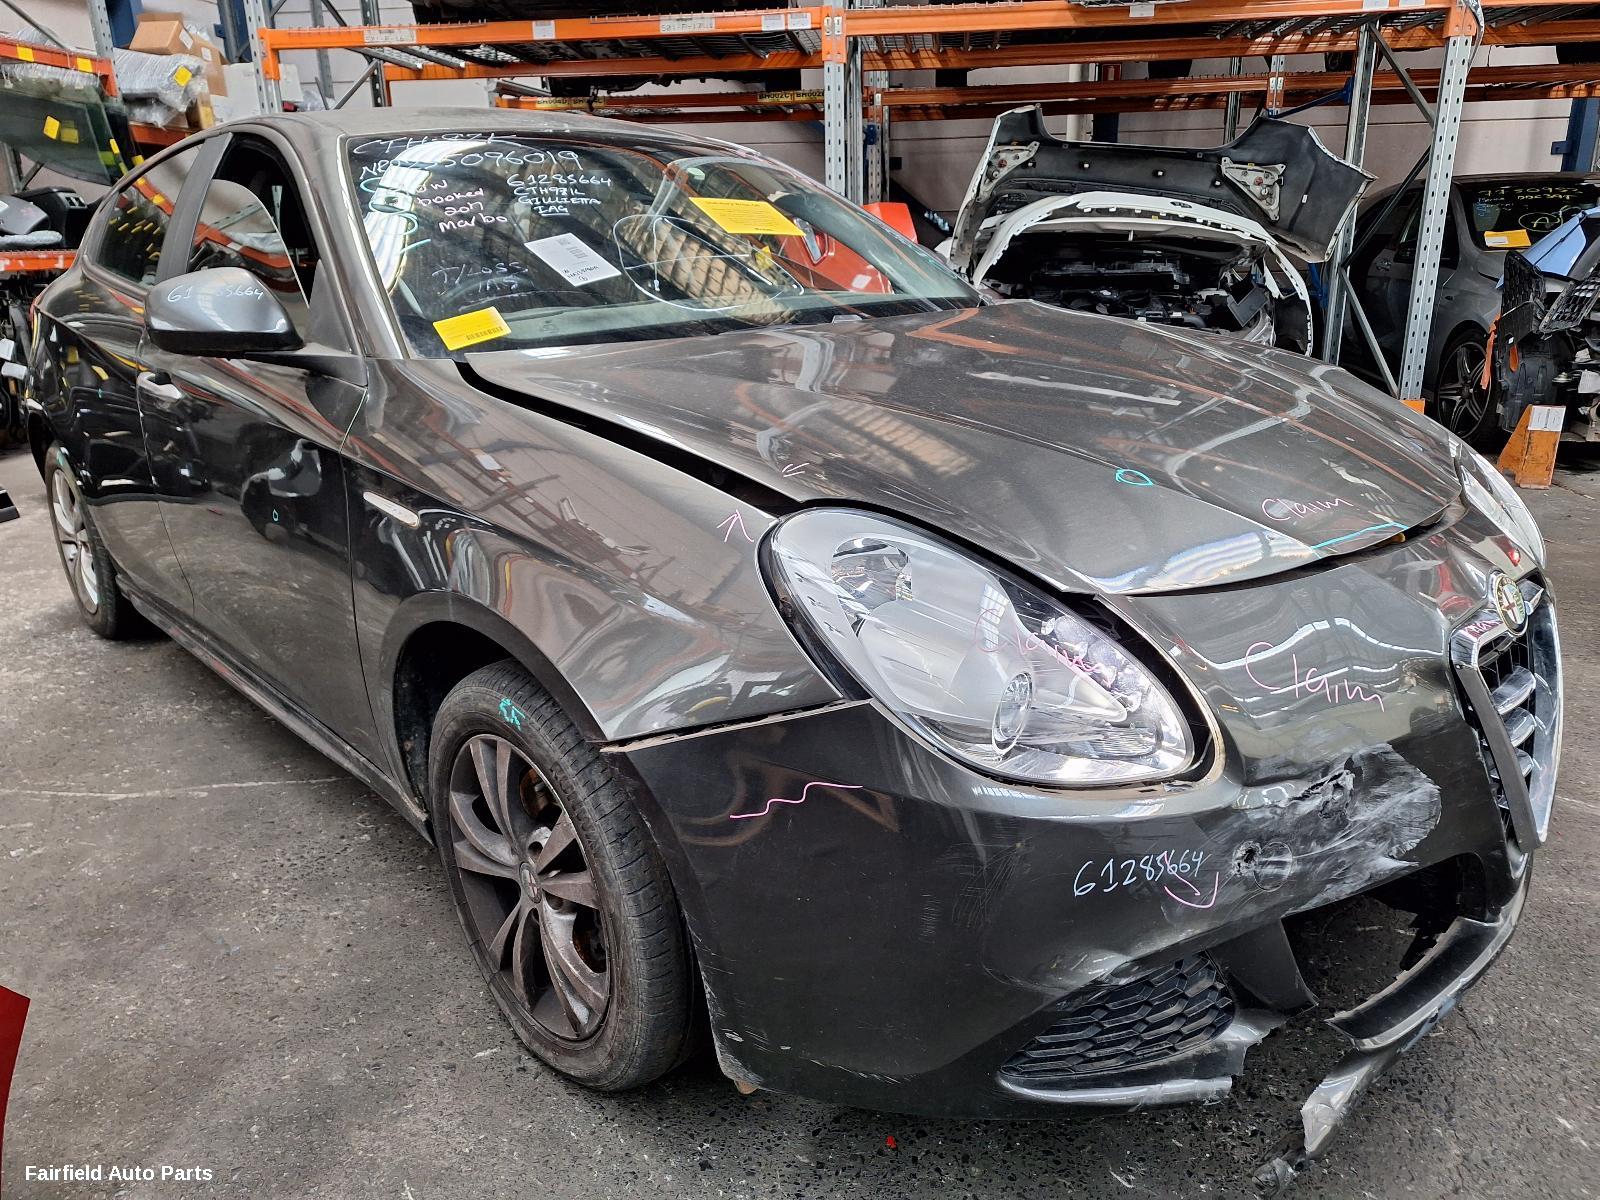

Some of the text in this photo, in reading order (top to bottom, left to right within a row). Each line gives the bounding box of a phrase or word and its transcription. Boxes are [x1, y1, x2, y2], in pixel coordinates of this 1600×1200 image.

[507, 174, 612, 188] 61285664
[1244, 641, 1386, 713] Claim
[1073, 849, 1204, 897] 61285664
